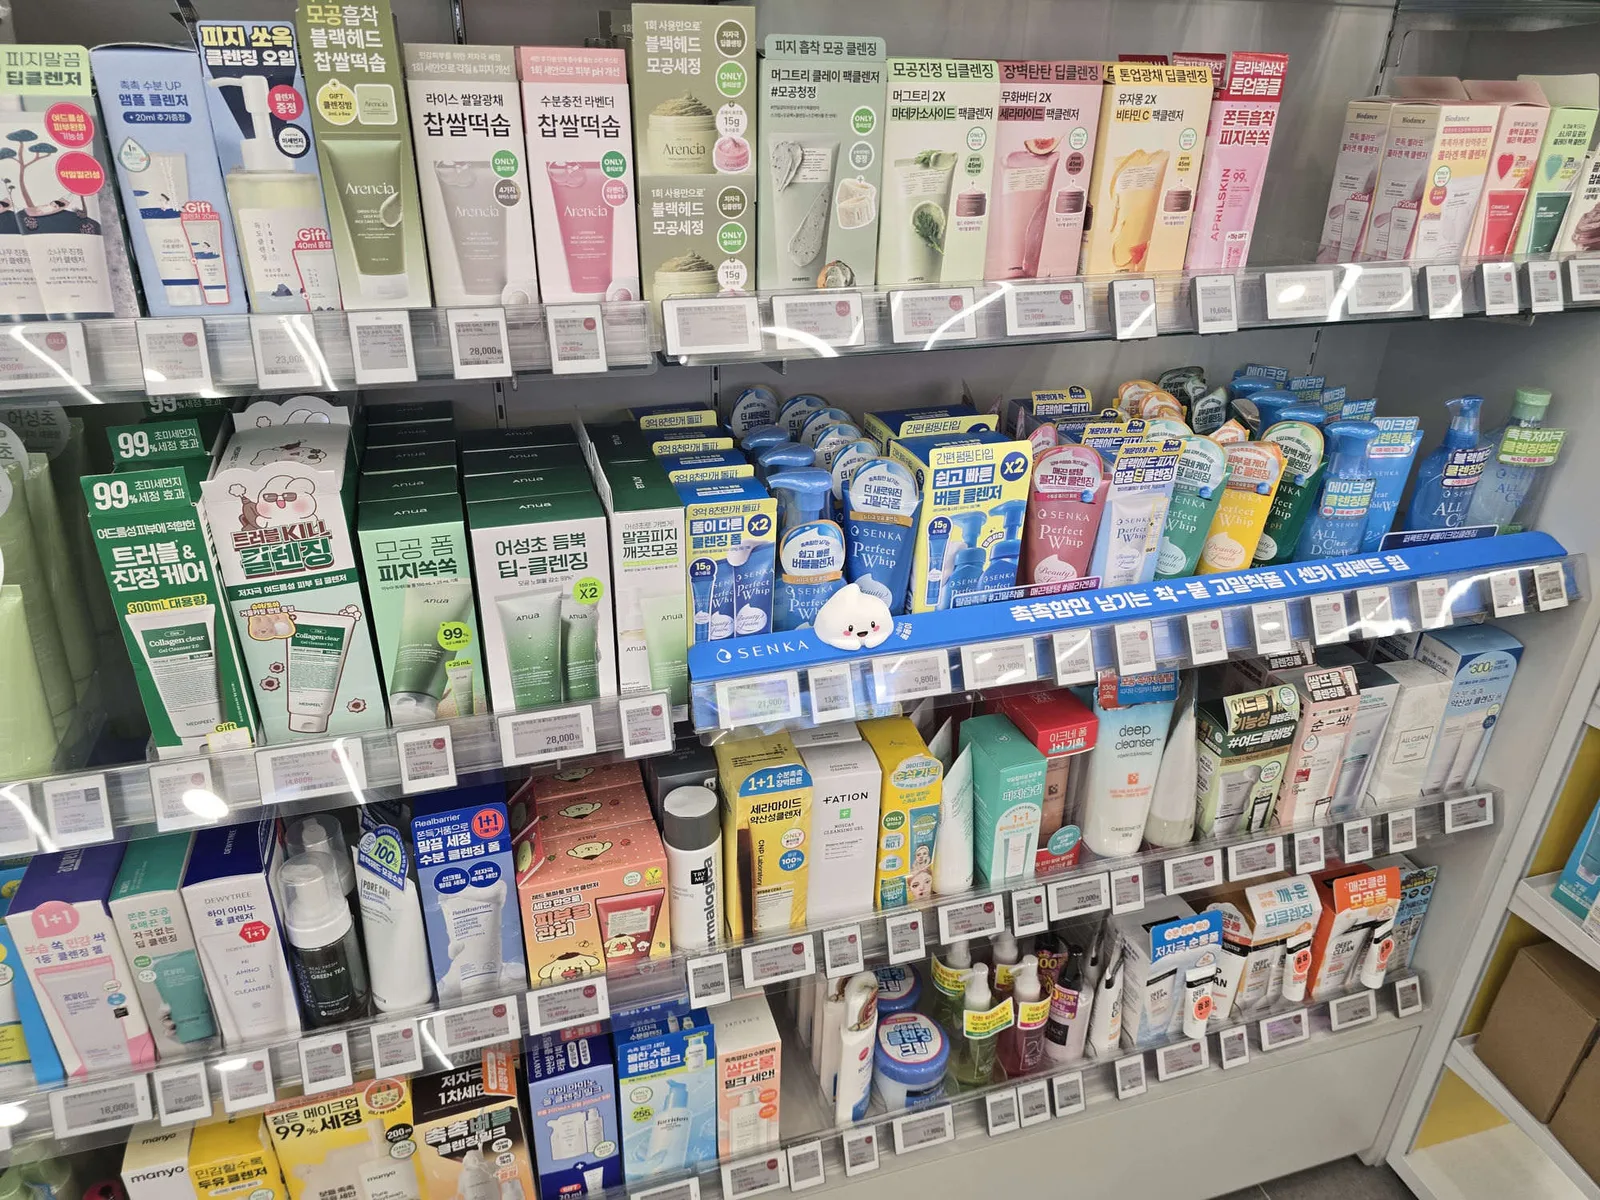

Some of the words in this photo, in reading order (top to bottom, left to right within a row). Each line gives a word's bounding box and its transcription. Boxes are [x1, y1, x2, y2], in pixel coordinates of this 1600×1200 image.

[202, 26, 246, 47] 피지
[251, 27, 294, 48] 쏘옥
[310, 29, 384, 49] 블랙헤드
[775, 41, 797, 54] 피지
[800, 41, 820, 54] 흡착
[823, 42, 842, 55] 모공
[846, 42, 877, 56] 클렌징
[6, 52, 80, 67] 피지말끔
[206, 50, 259, 67] 클렌징
[262, 51, 296, 67] 오일
[6, 71, 82, 86] 딥클렌저
[771, 69, 810, 83] 머그트리
[813, 70, 841, 83] 클레이
[843, 70, 880, 84] 팩클렌저
[893, 63, 943, 78] 모공진정
[945, 64, 994, 79] 딥클렌징
[1120, 68, 1163, 83] 톤업광채
[1165, 69, 1208, 84] 딥클렌징
[771, 86, 816, 98] #모공청정
[1229, 78, 1282, 97] 톤업폼클
[119, 94, 146, 107] 앰플
[149, 94, 190, 107] 클렌저
[426, 93, 459, 106] 라이스
[461, 94, 504, 107] 쌀알광채
[541, 96, 583, 108] 수분충전
[585, 96, 615, 108] 라벤더
[893, 91, 930, 103] 머그트리
[932, 91, 946, 103] 2X
[1118, 94, 1143, 106] 유자몽
[1144, 94, 1157, 105] 2X
[892, 107, 956, 120] 마데카소사이드
[958, 107, 993, 121] 팩클렌저
[1000, 107, 1043, 120] 세라마이드
[1046, 107, 1079, 121] 팩클렌저
[1223, 110, 1275, 127] 쫀득흡착
[423, 112, 511, 138] 찹쌀떡솝
[538, 114, 621, 138] 찹쌀떡솝
[1219, 130, 1271, 146] 피지쏙쏙
[604, 158, 623, 166] ONLY
[345, 183, 395, 195] Arencia
[185, 203, 212, 213] Gift
[455, 206, 499, 218] Arencia
[564, 206, 608, 218] Arencia
[651, 202, 704, 216] 블랙헤드
[1211, 168, 1231, 242] APRILSKIN
[299, 228, 327, 242] Gift
[653, 220, 704, 236] 모공세정
[722, 232, 743, 240] ONLY
[1246, 366, 1287, 382] 메이크업
[8, 411, 57, 426] 어성초
[943, 420, 961, 431] 타입
[155, 428, 196, 440] 초미세먼지
[1507, 428, 1566, 442] 촉촉저자극
[1502, 441, 1560, 455] 클렌징워터
[135, 477, 182, 491] 초미세먼지
[935, 470, 964, 487] 쉽고
[966, 467, 994, 483] 빠른
[1328, 480, 1374, 494] 메이크업
[933, 489, 960, 506] 버블
[963, 485, 1002, 503] 클렌저
[393, 508, 428, 516] Anua
[1433, 502, 1463, 515] ALL
[622, 528, 677, 543] 말끔피지
[863, 528, 902, 541] SENKA
[1312, 530, 1338, 540] ALL
[376, 538, 424, 562] 모공
[431, 535, 454, 556] 폼
[623, 543, 678, 559] 깨끗모공
[378, 558, 457, 582] 피지쏙쏙
[498, 553, 589, 579] 딥-클렌징
[111, 567, 160, 592] 진정
[161, 561, 209, 586] 케어
[799, 584, 833, 594] SENKA
[1009, 597, 1094, 622] 촉촉함만
[1094, 590, 1152, 612] 남기는
[1208, 571, 1286, 596] 고밀착폼
[1298, 564, 1336, 583] 센카
[1338, 557, 1388, 579] 퍼펙트
[1388, 553, 1410, 571] 휩
[128, 602, 169, 614] 300mL
[169, 596, 206, 608] 대용량
[516, 612, 540, 622] Anua
[661, 613, 683, 621] Anua
[149, 637, 185, 648] Collagen
[185, 635, 205, 643] clear
[295, 633, 324, 641] Collagen
[737, 639, 809, 660] SENKA
[215, 723, 236, 733] Gift
[1231, 712, 1270, 732] 기능성
[1049, 731, 1077, 744] 아크네
[1078, 727, 1088, 738] 폼
[1119, 724, 1152, 738] deep
[546, 733, 576, 745] 28,000
[1115, 738, 1156, 750] cleanser
[1401, 736, 1412, 744] ALL
[823, 791, 869, 805] FATION
[750, 798, 802, 814] 세라마이드
[477, 813, 499, 828] 1+1
[749, 808, 802, 825] 약산성클렌저
[416, 823, 469, 839] 쫀득거품으로
[418, 837, 444, 853] 말끔
[446, 832, 471, 849] 세정
[885, 840, 901, 849] NO.1
[693, 871, 707, 879] TRY
[205, 892, 252, 904] DEWYTREE
[1350, 888, 1387, 909] 모공폼
[207, 908, 226, 918] 하이
[228, 904, 256, 915] 아미노
[533, 904, 592, 926] 피부결
[1265, 904, 1313, 927] 딥클렌징
[38, 910, 73, 928] 1+1
[215, 916, 224, 926] 올
[227, 912, 254, 925] 클렌저
[536, 922, 576, 943] 관리
[135, 940, 147, 949] 딥
[149, 934, 178, 947] 클렌징
[1155, 939, 1187, 958] 저자극
[888, 1028, 932, 1046] 클렌징
[900, 1043, 928, 1057] 크림
[628, 1060, 659, 1075] 클렌징
[660, 1053, 682, 1067] 밀크
[568, 1079, 597, 1092] 아미노
[271, 1110, 299, 1126] 짙은
[303, 1096, 359, 1119] 메이크업
[142, 1131, 177, 1146] manyo
[131, 1164, 185, 1184] manyo
[198, 1177, 225, 1190] 두유
[227, 1167, 268, 1184] 클렌저
[367, 1170, 396, 1182] manyo
